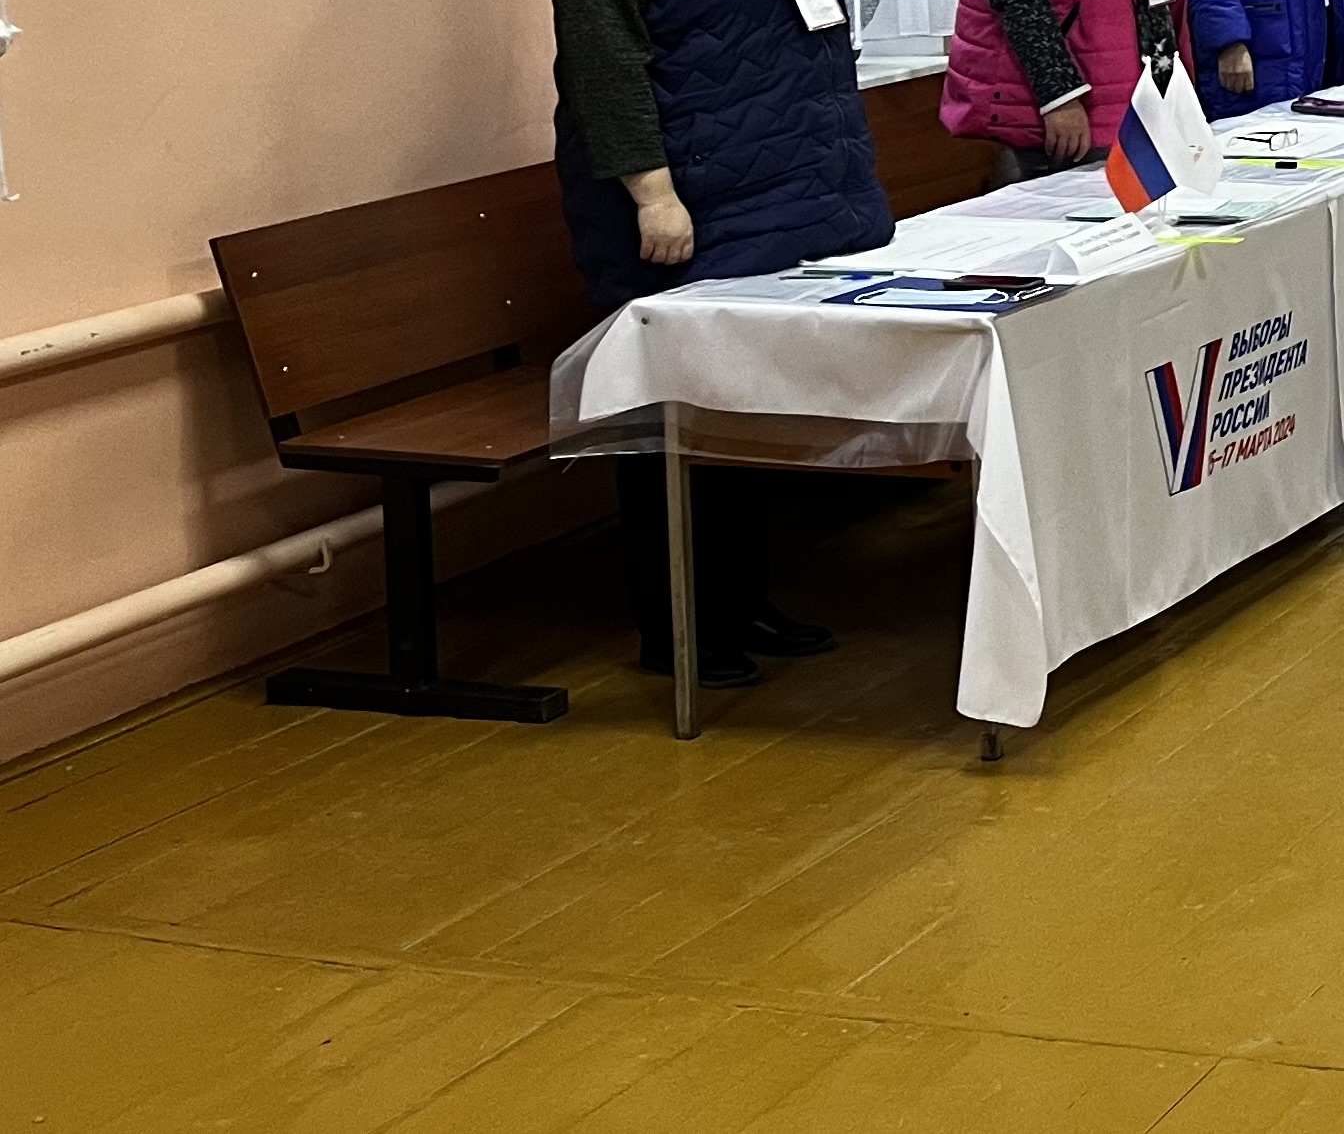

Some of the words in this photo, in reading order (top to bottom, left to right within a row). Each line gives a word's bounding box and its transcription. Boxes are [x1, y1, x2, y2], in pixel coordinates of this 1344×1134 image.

[1228, 311, 1292, 361] ВЫБОРЫ
[1218, 339, 1308, 402] ПРЕЗИДЕНТА
[1210, 390, 1270, 442] РОССИИ
[1235, 425, 1273, 464] МАРТА
[1272, 414, 1296, 446] 2024
